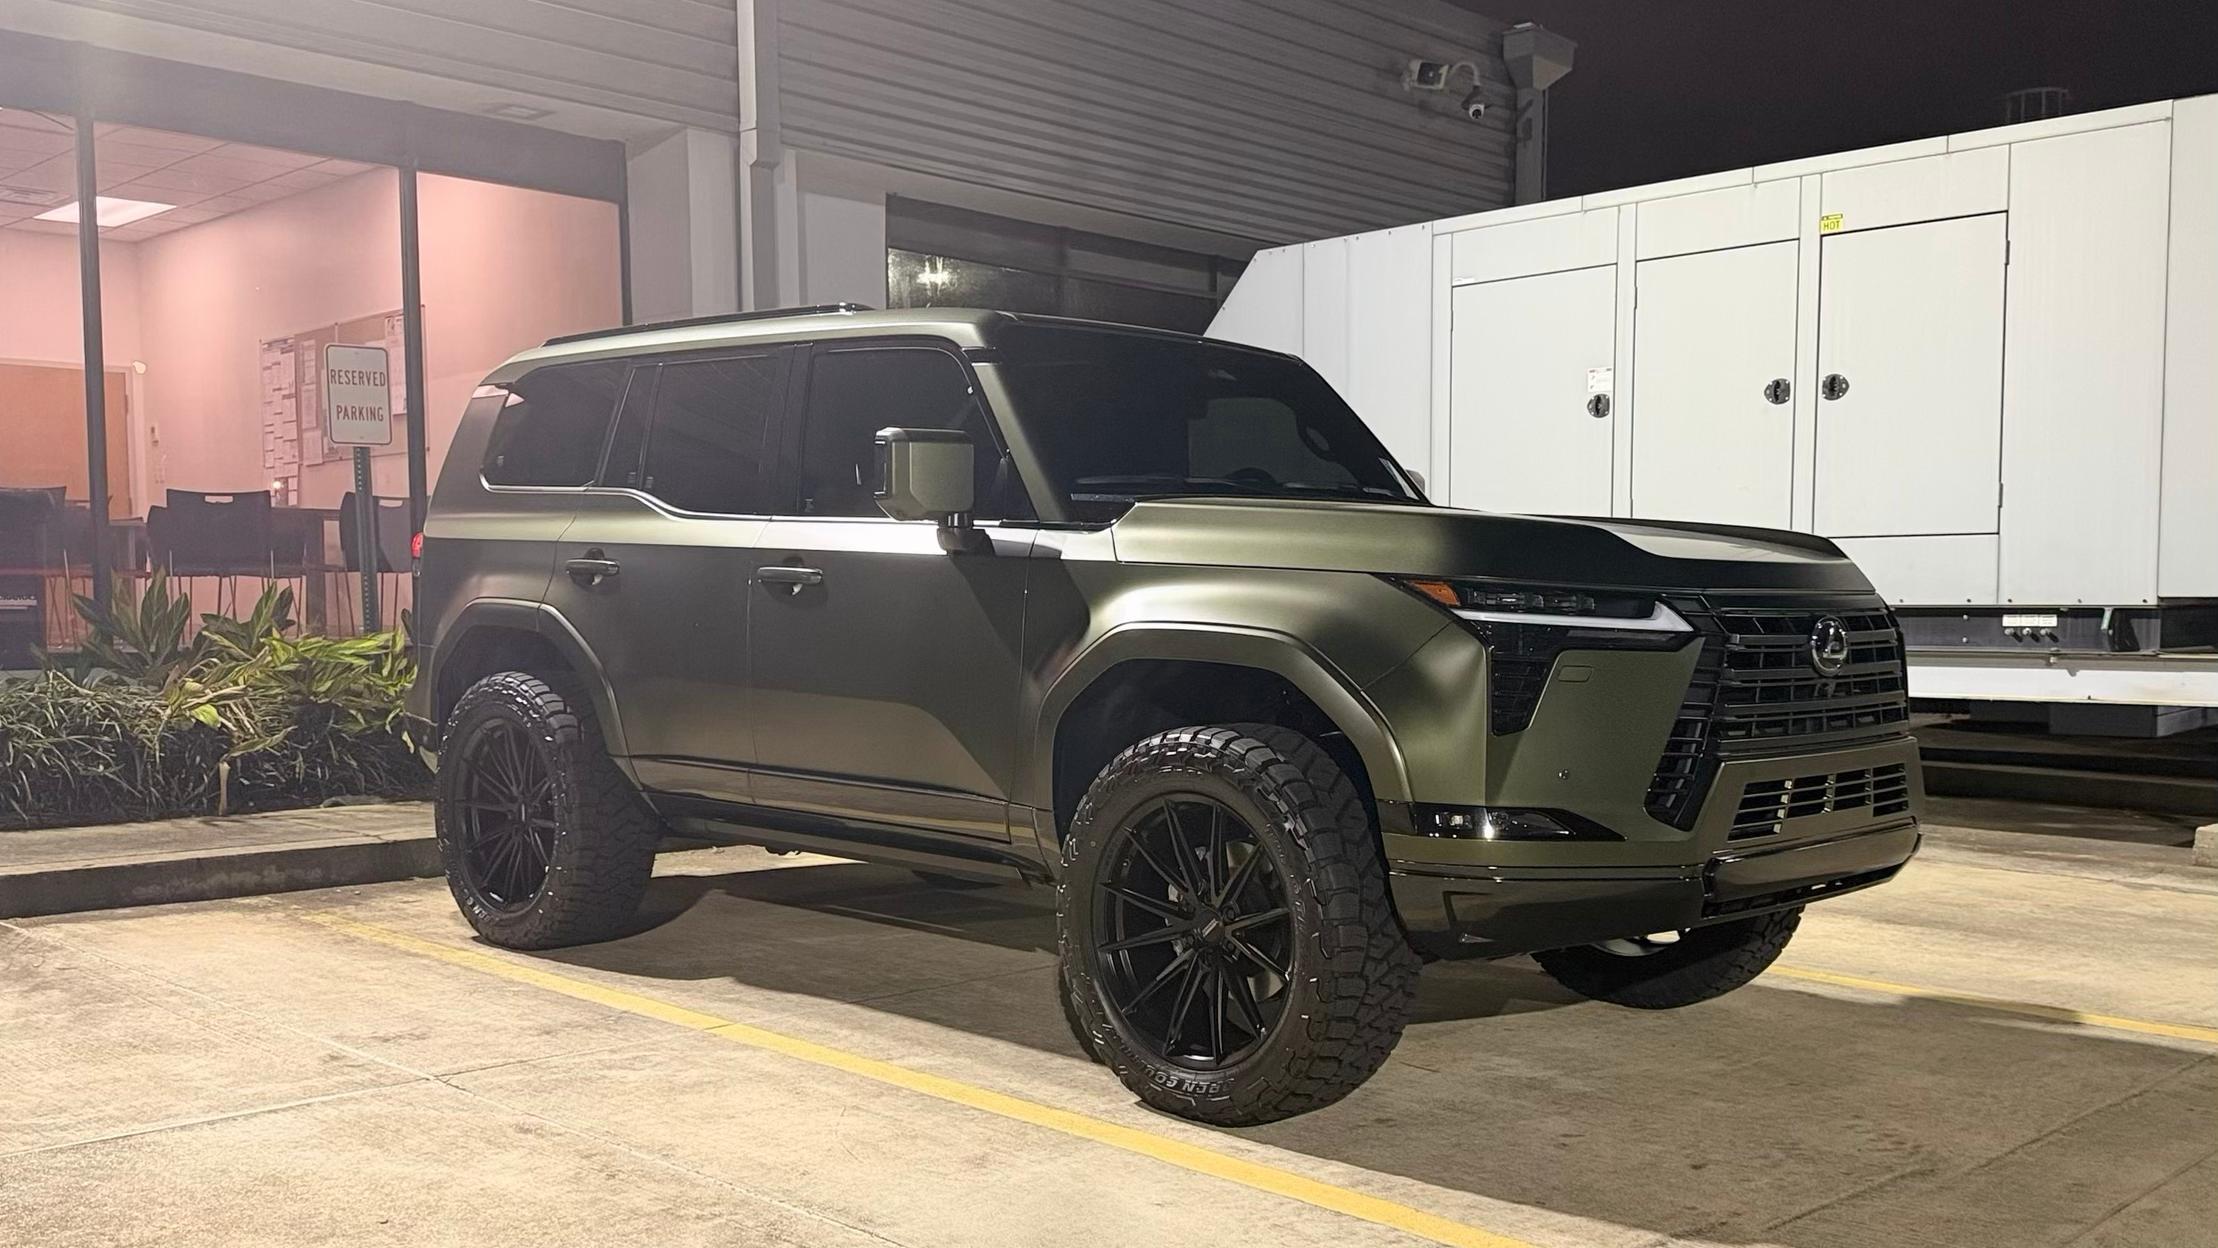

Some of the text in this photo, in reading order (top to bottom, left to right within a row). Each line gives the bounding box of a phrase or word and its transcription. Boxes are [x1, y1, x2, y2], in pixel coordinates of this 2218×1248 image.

[1823, 220, 1840, 230] HOT
[330, 368, 386, 387] RESERVED
[336, 404, 384, 422] PARKING
